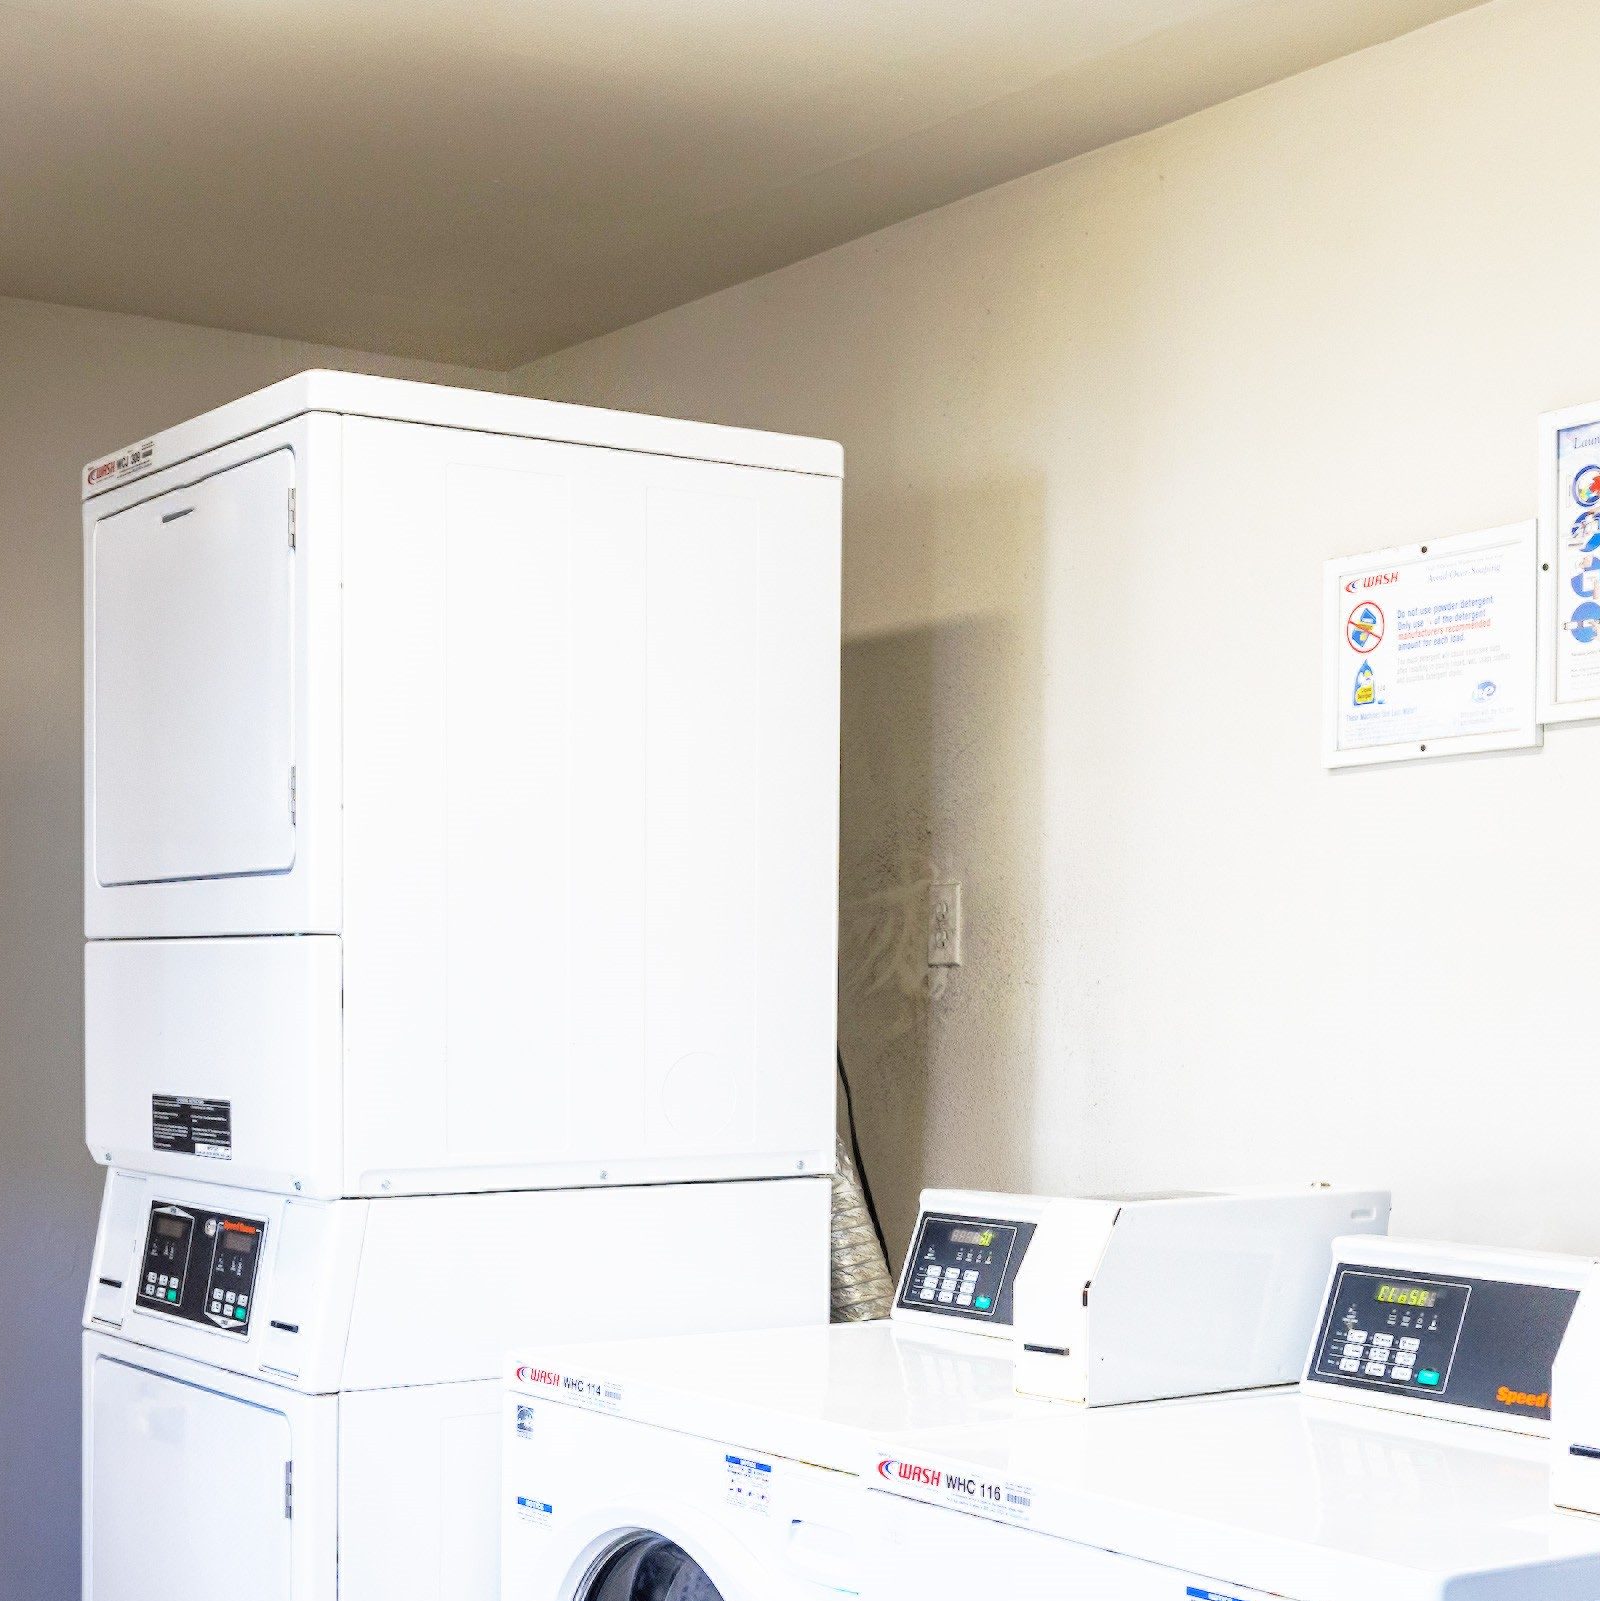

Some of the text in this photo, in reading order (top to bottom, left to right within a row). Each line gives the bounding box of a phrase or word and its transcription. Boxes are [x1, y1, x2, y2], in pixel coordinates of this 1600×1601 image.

[1363, 570, 1401, 589] WASH
[1428, 572, 1447, 583] Avoid
[1397, 594, 1494, 619] Do not use powder detergent
[1397, 620, 1411, 633] Only
[1413, 620, 1424, 629] use
[1434, 615, 1440, 625] of
[1442, 614, 1452, 623] the
[1455, 608, 1485, 624] detergent
[1398, 618, 1491, 642] manufacturers recommended
[1398, 640, 1421, 652] amount
[1422, 638, 1431, 648] for
[1433, 635, 1448, 646] each
[530, 1368, 560, 1386] WASH
[564, 1376, 584, 1392] WHC
[587, 1382, 601, 1396] 114
[1496, 1385, 1548, 1408] Speed
[898, 1462, 942, 1487] WASH
[946, 1473, 976, 1494] WHC
[980, 1484, 1001, 1501] 116
